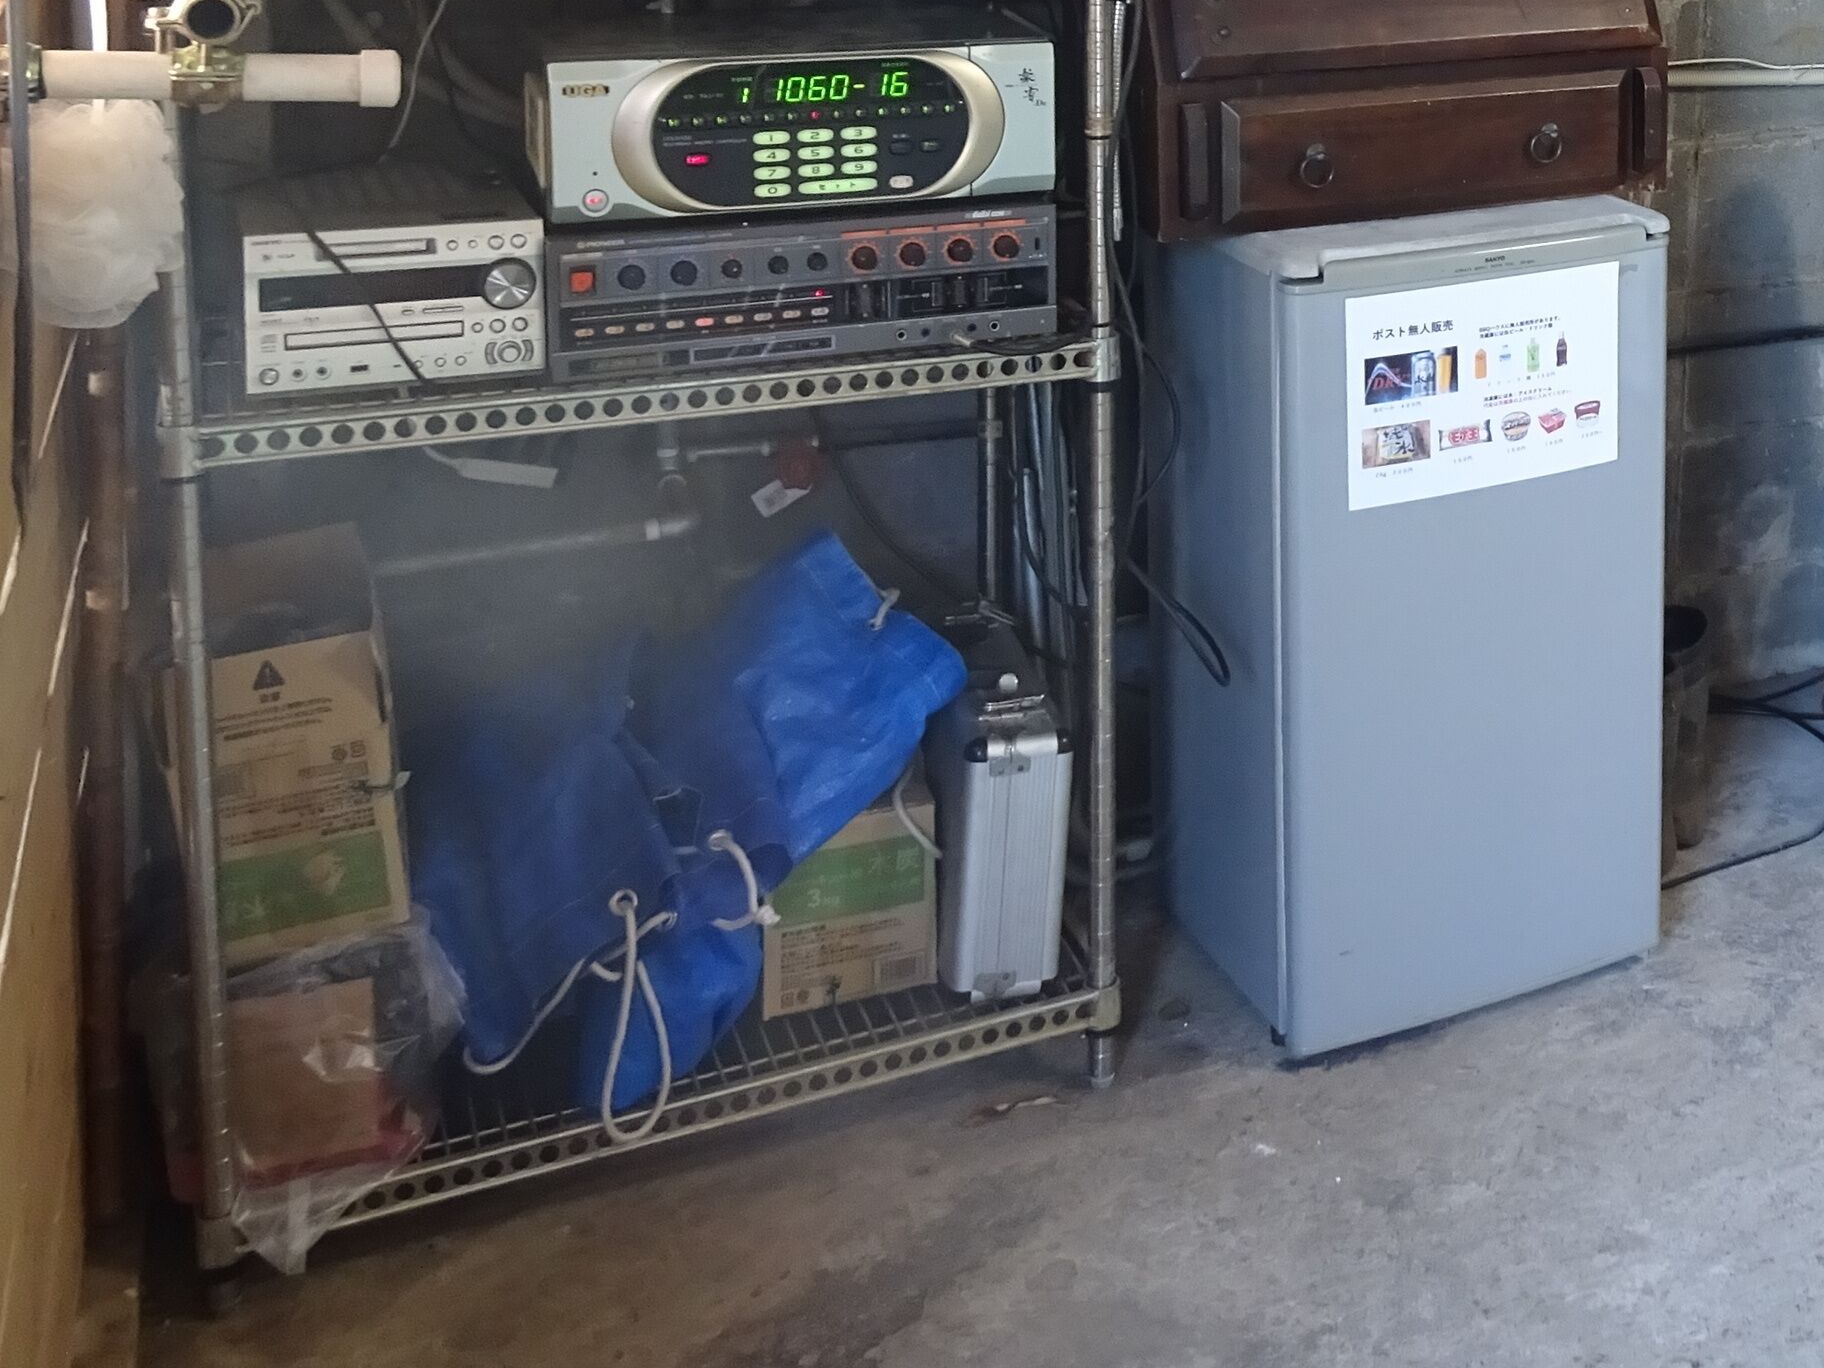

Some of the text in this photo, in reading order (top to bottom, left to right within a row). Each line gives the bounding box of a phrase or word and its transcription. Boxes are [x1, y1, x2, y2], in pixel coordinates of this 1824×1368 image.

[1372, 319, 1454, 341] ポスト無人販売
